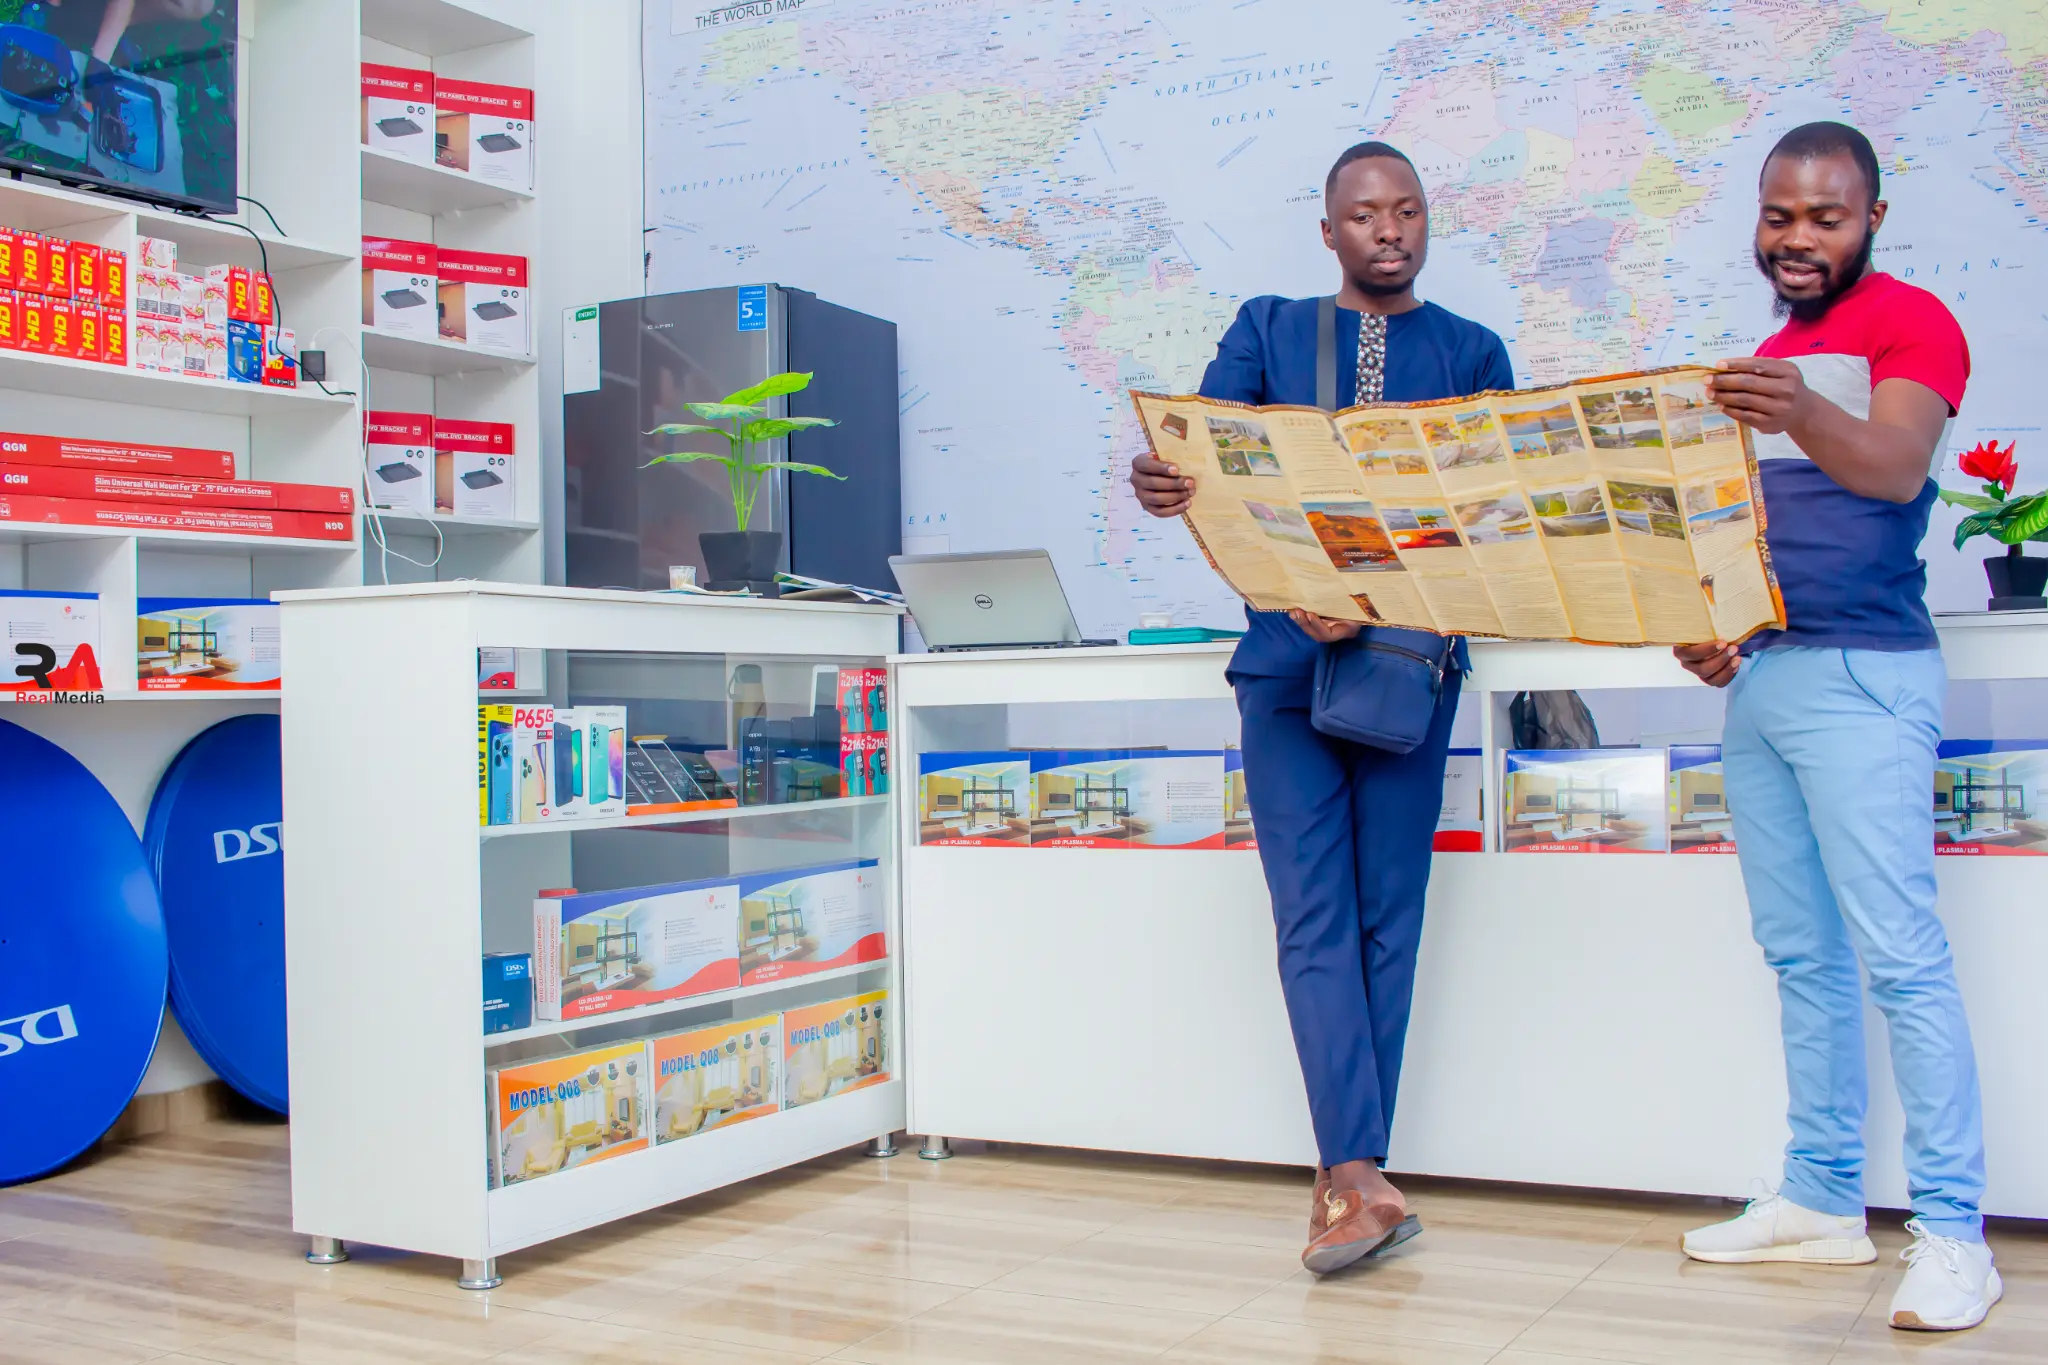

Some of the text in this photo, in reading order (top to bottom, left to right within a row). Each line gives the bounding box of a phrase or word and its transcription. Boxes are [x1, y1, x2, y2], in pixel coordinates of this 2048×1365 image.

[696, 0, 804, 28] THE WORLD MAP
[1728, 40, 1759, 50] IRAN
[1154, 60, 1330, 97] NORTH ATLANTIC
[1851, 67, 1927, 83] INDIA
[1974, 69, 2014, 78] MYANMAR
[381, 79, 409, 88] BRACKET
[448, 93, 466, 101] PANEL
[481, 96, 508, 106] BRACKET
[1525, 96, 1558, 104] LIBYA
[1436, 104, 1470, 115] ALGERIA
[1583, 106, 1618, 116] EGYPT
[1673, 104, 1708, 113] ARABIA
[1212, 108, 1276, 127] OCEAN
[1481, 154, 1514, 164] NIGER
[1422, 162, 1461, 172] MALI
[1534, 164, 1556, 172] CHAD
[660, 158, 851, 195] NORTH PACIFIC OCEAN
[1648, 188, 1682, 196] ETHIOPIA
[1476, 194, 1505, 202] NIGERIA
[22, 238, 38, 246] QGN
[51, 244, 66, 252] QGN
[386, 253, 412, 261] BRACKET
[24, 248, 38, 281] HD
[476, 265, 503, 273] BRACKET
[1620, 262, 1656, 270] TANZANIA
[52, 254, 65, 286] HD
[80, 254, 93, 286] HD
[109, 265, 121, 296] HD
[235, 281, 246, 310] HD
[258, 286, 268, 314] HD
[53, 305, 69, 313] QGN
[81, 310, 96, 318] QGN
[742, 302, 753, 318] 5
[578, 310, 596, 319] ENERGY
[1533, 321, 1566, 329] ANGOLA
[1576, 316, 1612, 324] ZAMBIA
[26, 310, 40, 342] HD
[54, 314, 67, 346] HD
[82, 319, 95, 350] HD
[1148, 324, 1224, 339] BRAZI
[109, 324, 122, 354] HD
[1702, 337, 1756, 346] MADAGASCAR
[1124, 374, 1156, 382] BOLIVIA
[3, 442, 27, 452] QGN
[4, 474, 28, 484] QGN
[95, 477, 110, 486] Slim
[112, 479, 143, 488] Universal
[144, 480, 158, 489] Wall
[159, 482, 179, 490] Mount
[96, 513, 124, 521] Screens
[196, 518, 215, 527] Mount
[216, 519, 229, 528] Wall
[325, 522, 344, 530] QGN
[824, 1019, 840, 1038] Q08
[700, 1048, 719, 1068] Q08
[558, 1079, 581, 1100] Q08
